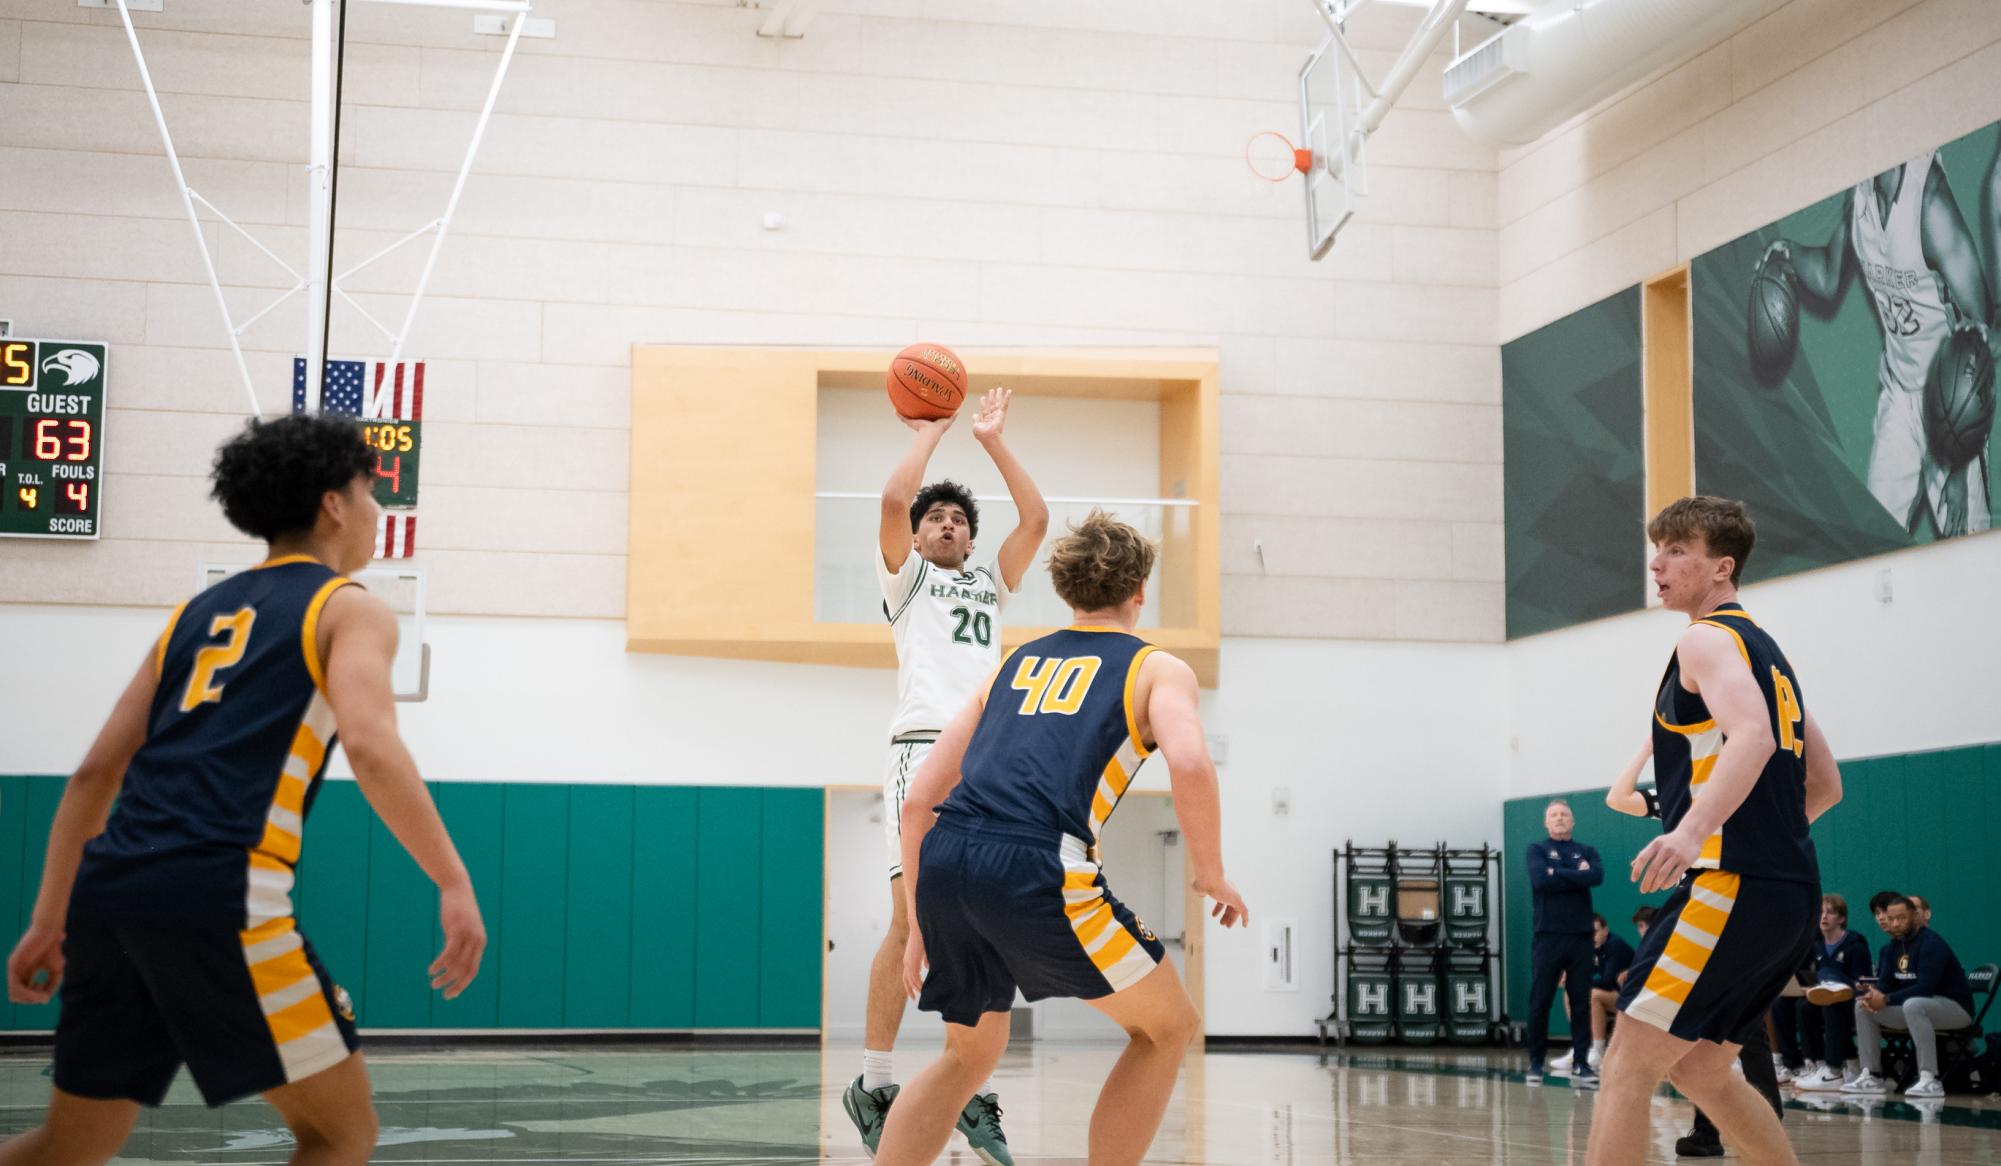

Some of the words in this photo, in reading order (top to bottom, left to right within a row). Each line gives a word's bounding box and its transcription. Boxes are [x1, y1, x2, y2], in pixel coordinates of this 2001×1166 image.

[0, 344, 29, 384] 5
[904, 362, 954, 402] SPALDING
[27, 393, 92, 414] GUEST
[35, 419, 91, 461] 63
[18, 473, 44, 485] T.O.L.
[52, 464, 95, 480] FOULS
[374, 455, 401, 494] 4
[19, 488, 37, 509] 4
[67, 483, 88, 511] 4
[49, 518, 93, 533] SCORE
[951, 605, 993, 649] 20
[178, 604, 257, 712] 2
[1011, 655, 1102, 716] 40
[1359, 886, 1389, 916] H
[1454, 886, 1483, 916] H
[1358, 983, 1388, 1015] H
[1406, 983, 1436, 1015] H
[1456, 983, 1487, 1013] H
